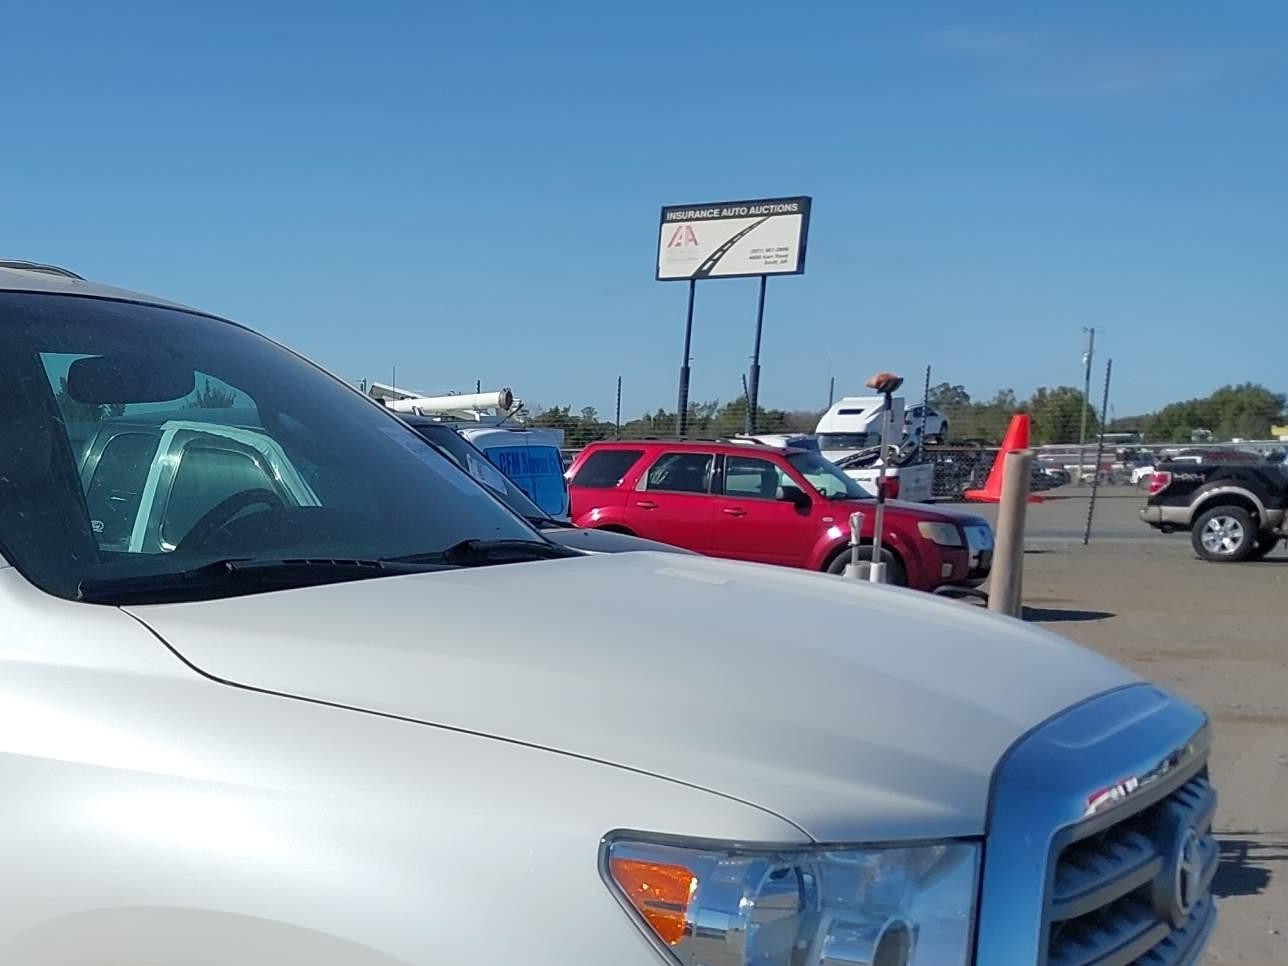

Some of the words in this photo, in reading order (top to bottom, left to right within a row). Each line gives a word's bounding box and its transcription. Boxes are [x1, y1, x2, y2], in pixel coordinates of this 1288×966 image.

[666, 208, 720, 220] INSURANCE
[721, 206, 748, 217] AUTO
[749, 203, 799, 215] AUCTIONS
